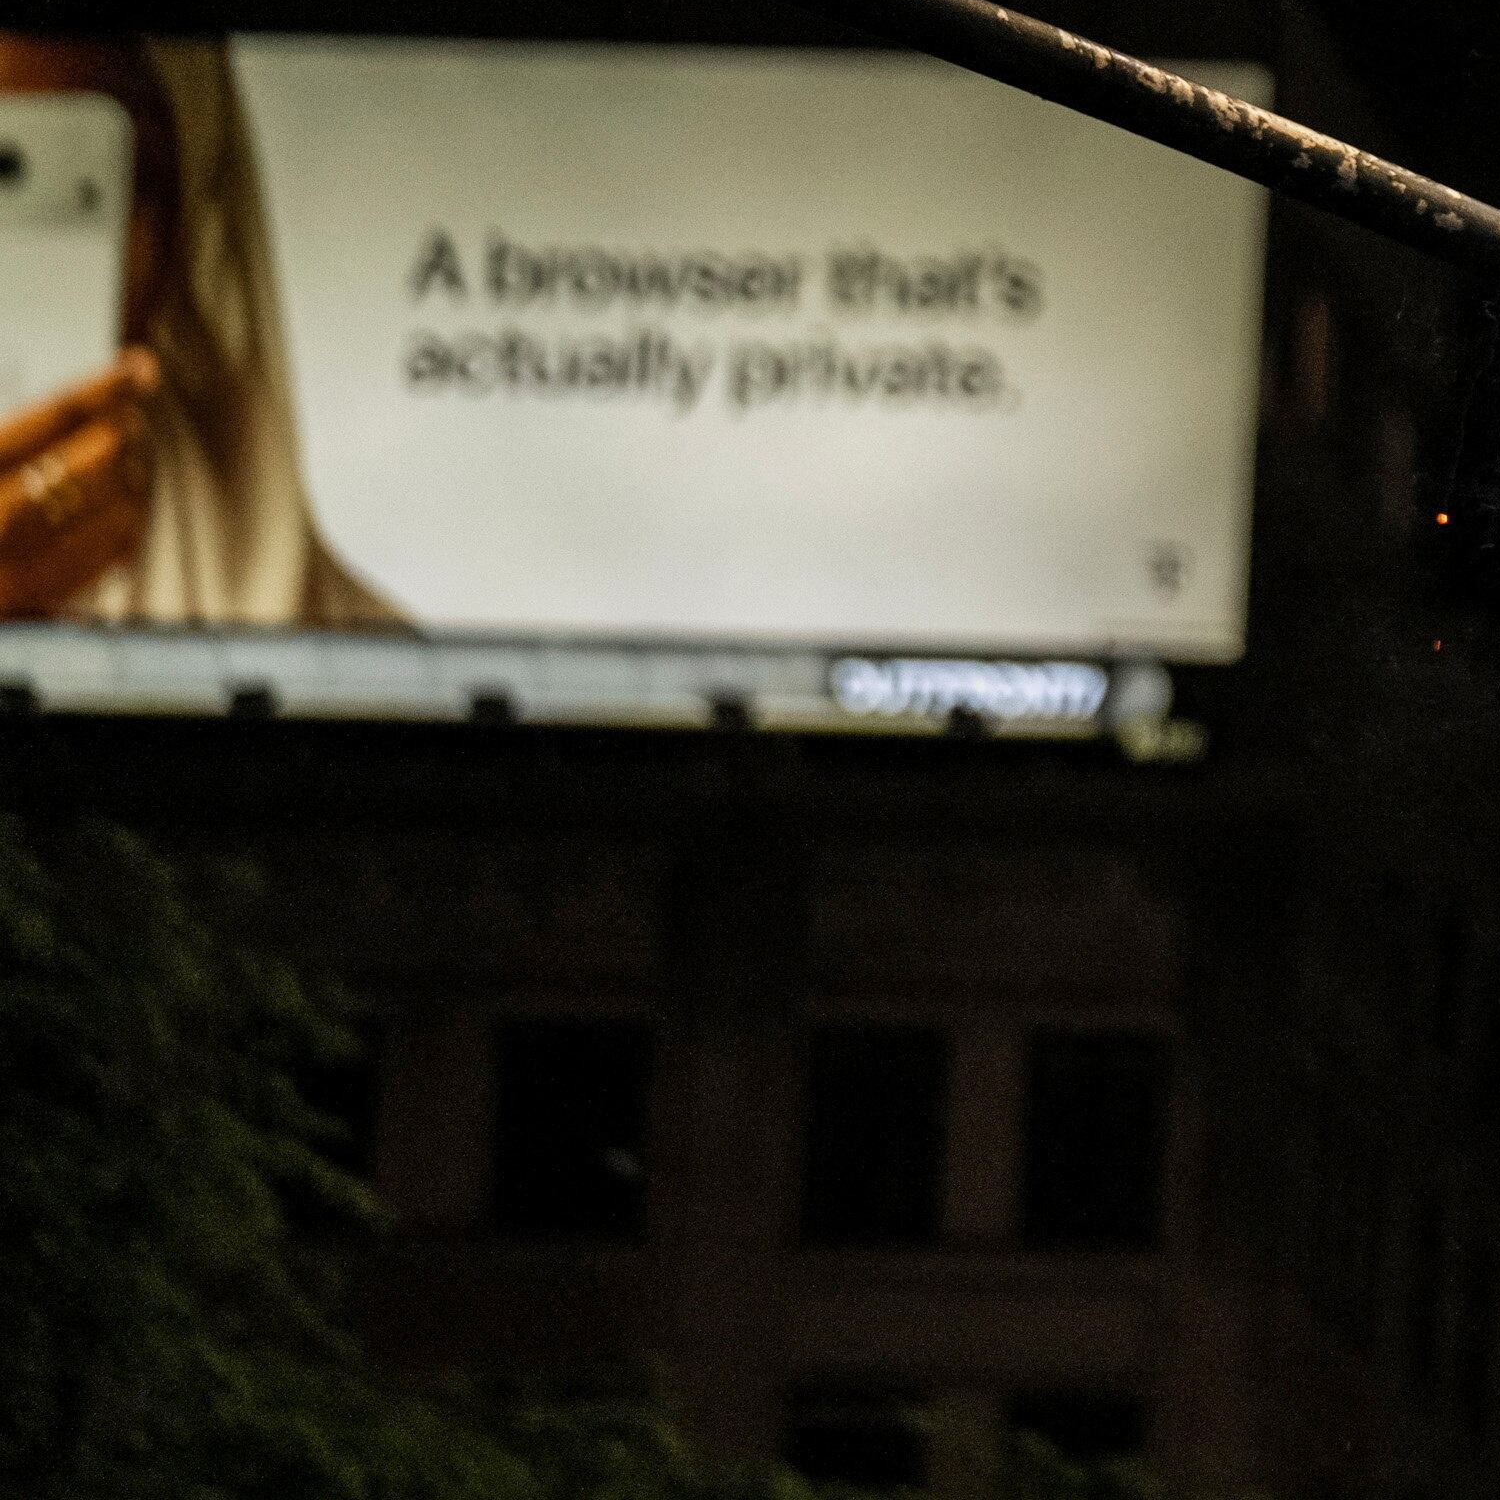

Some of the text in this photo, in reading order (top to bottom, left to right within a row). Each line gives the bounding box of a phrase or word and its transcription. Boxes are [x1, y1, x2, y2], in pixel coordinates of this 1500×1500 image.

[410, 227, 1042, 318] A browser that's
[406, 330, 1020, 412] actually private.
